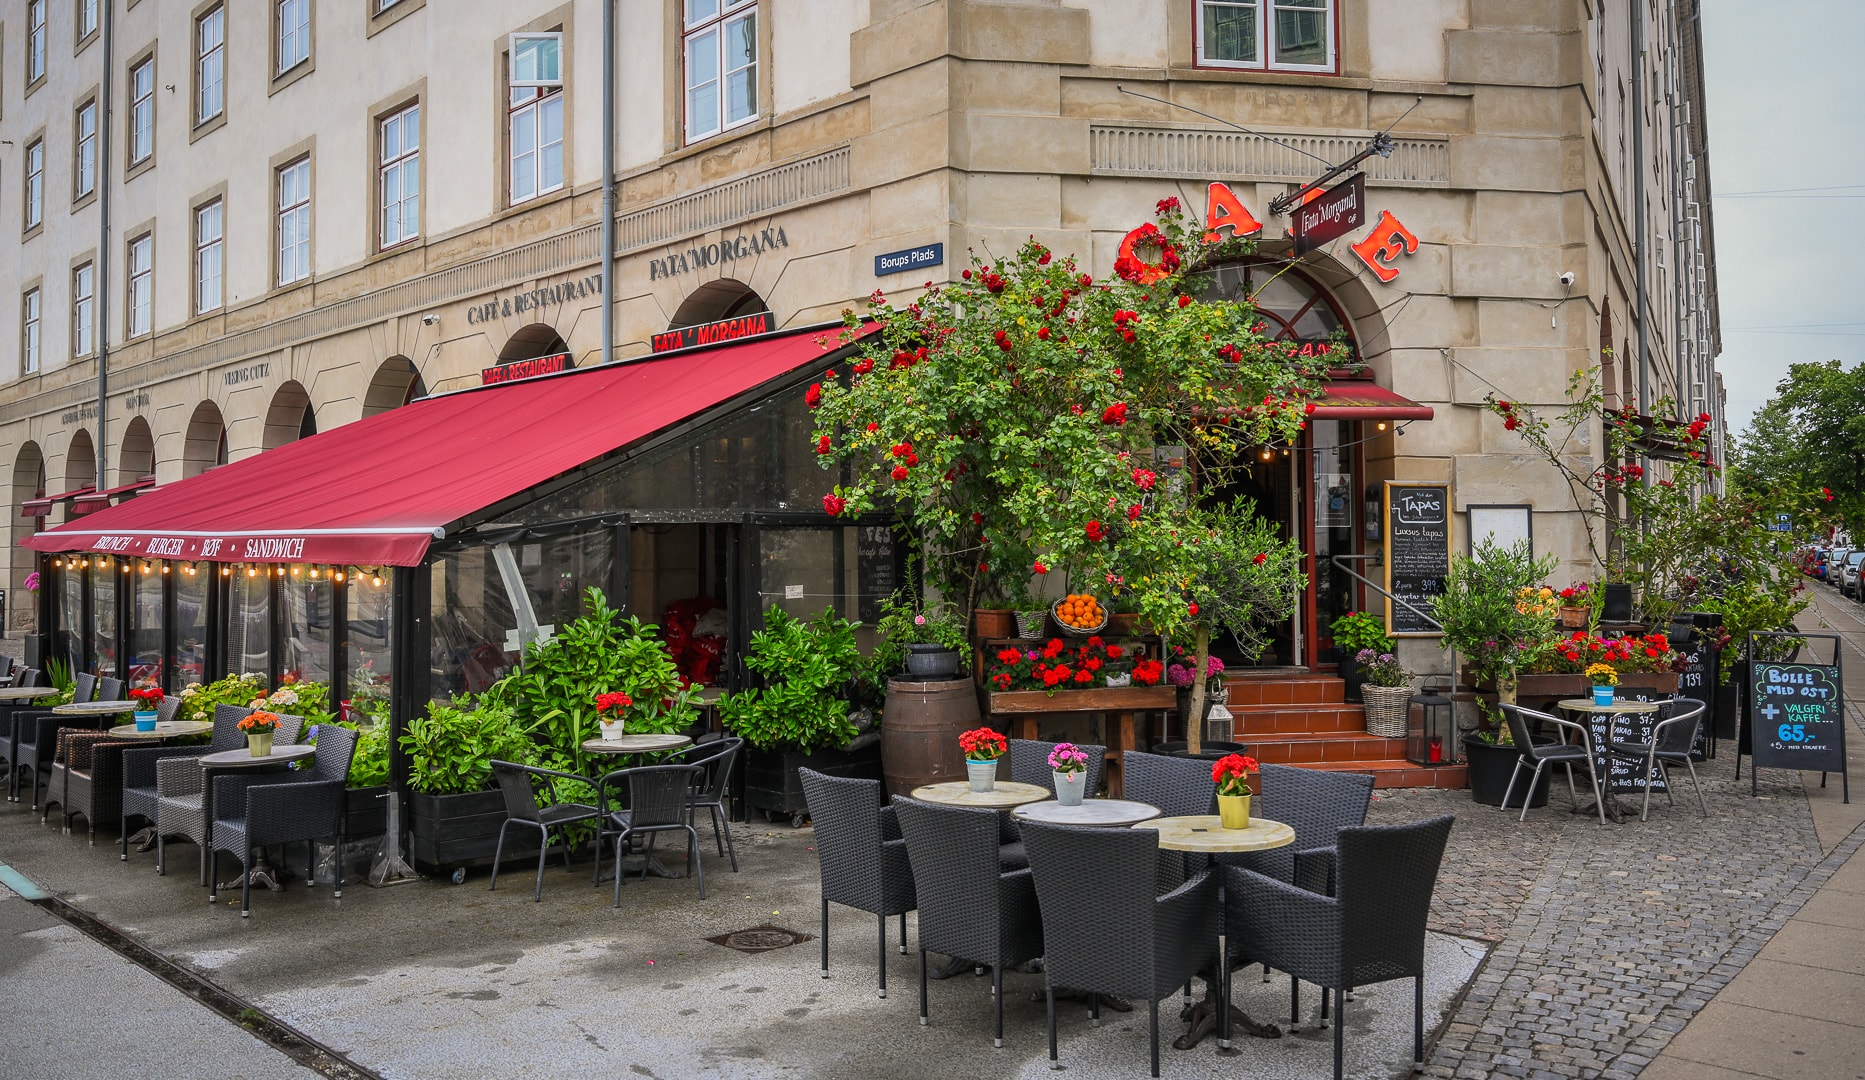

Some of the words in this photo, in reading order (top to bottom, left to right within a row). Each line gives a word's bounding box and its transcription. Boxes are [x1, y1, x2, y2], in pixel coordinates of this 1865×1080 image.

[881, 255, 909, 268] Borups
[911, 248, 935, 263] Plads
[501, 298, 512, 317] &
[514, 273, 602, 314] RESTAURANT
[697, 314, 767, 345] MORGANA
[250, 362, 270, 380] CUTZ
[508, 354, 566, 380] RESTAURANT
[1401, 496, 1440, 516] TAPAS
[1422, 526, 1444, 541] tapas
[92, 536, 134, 551] BRUNCH
[146, 537, 185, 556] BURGER
[200, 538, 223, 557] BØF
[244, 538, 305, 558] SANDWICH
[1769, 669, 1814, 685] BOLLE
[1766, 685, 1795, 695] MED
[1800, 686, 1828, 699] OST
[1784, 703, 1826, 715] VALGFRI
[1778, 723, 1816, 743] 65,-
